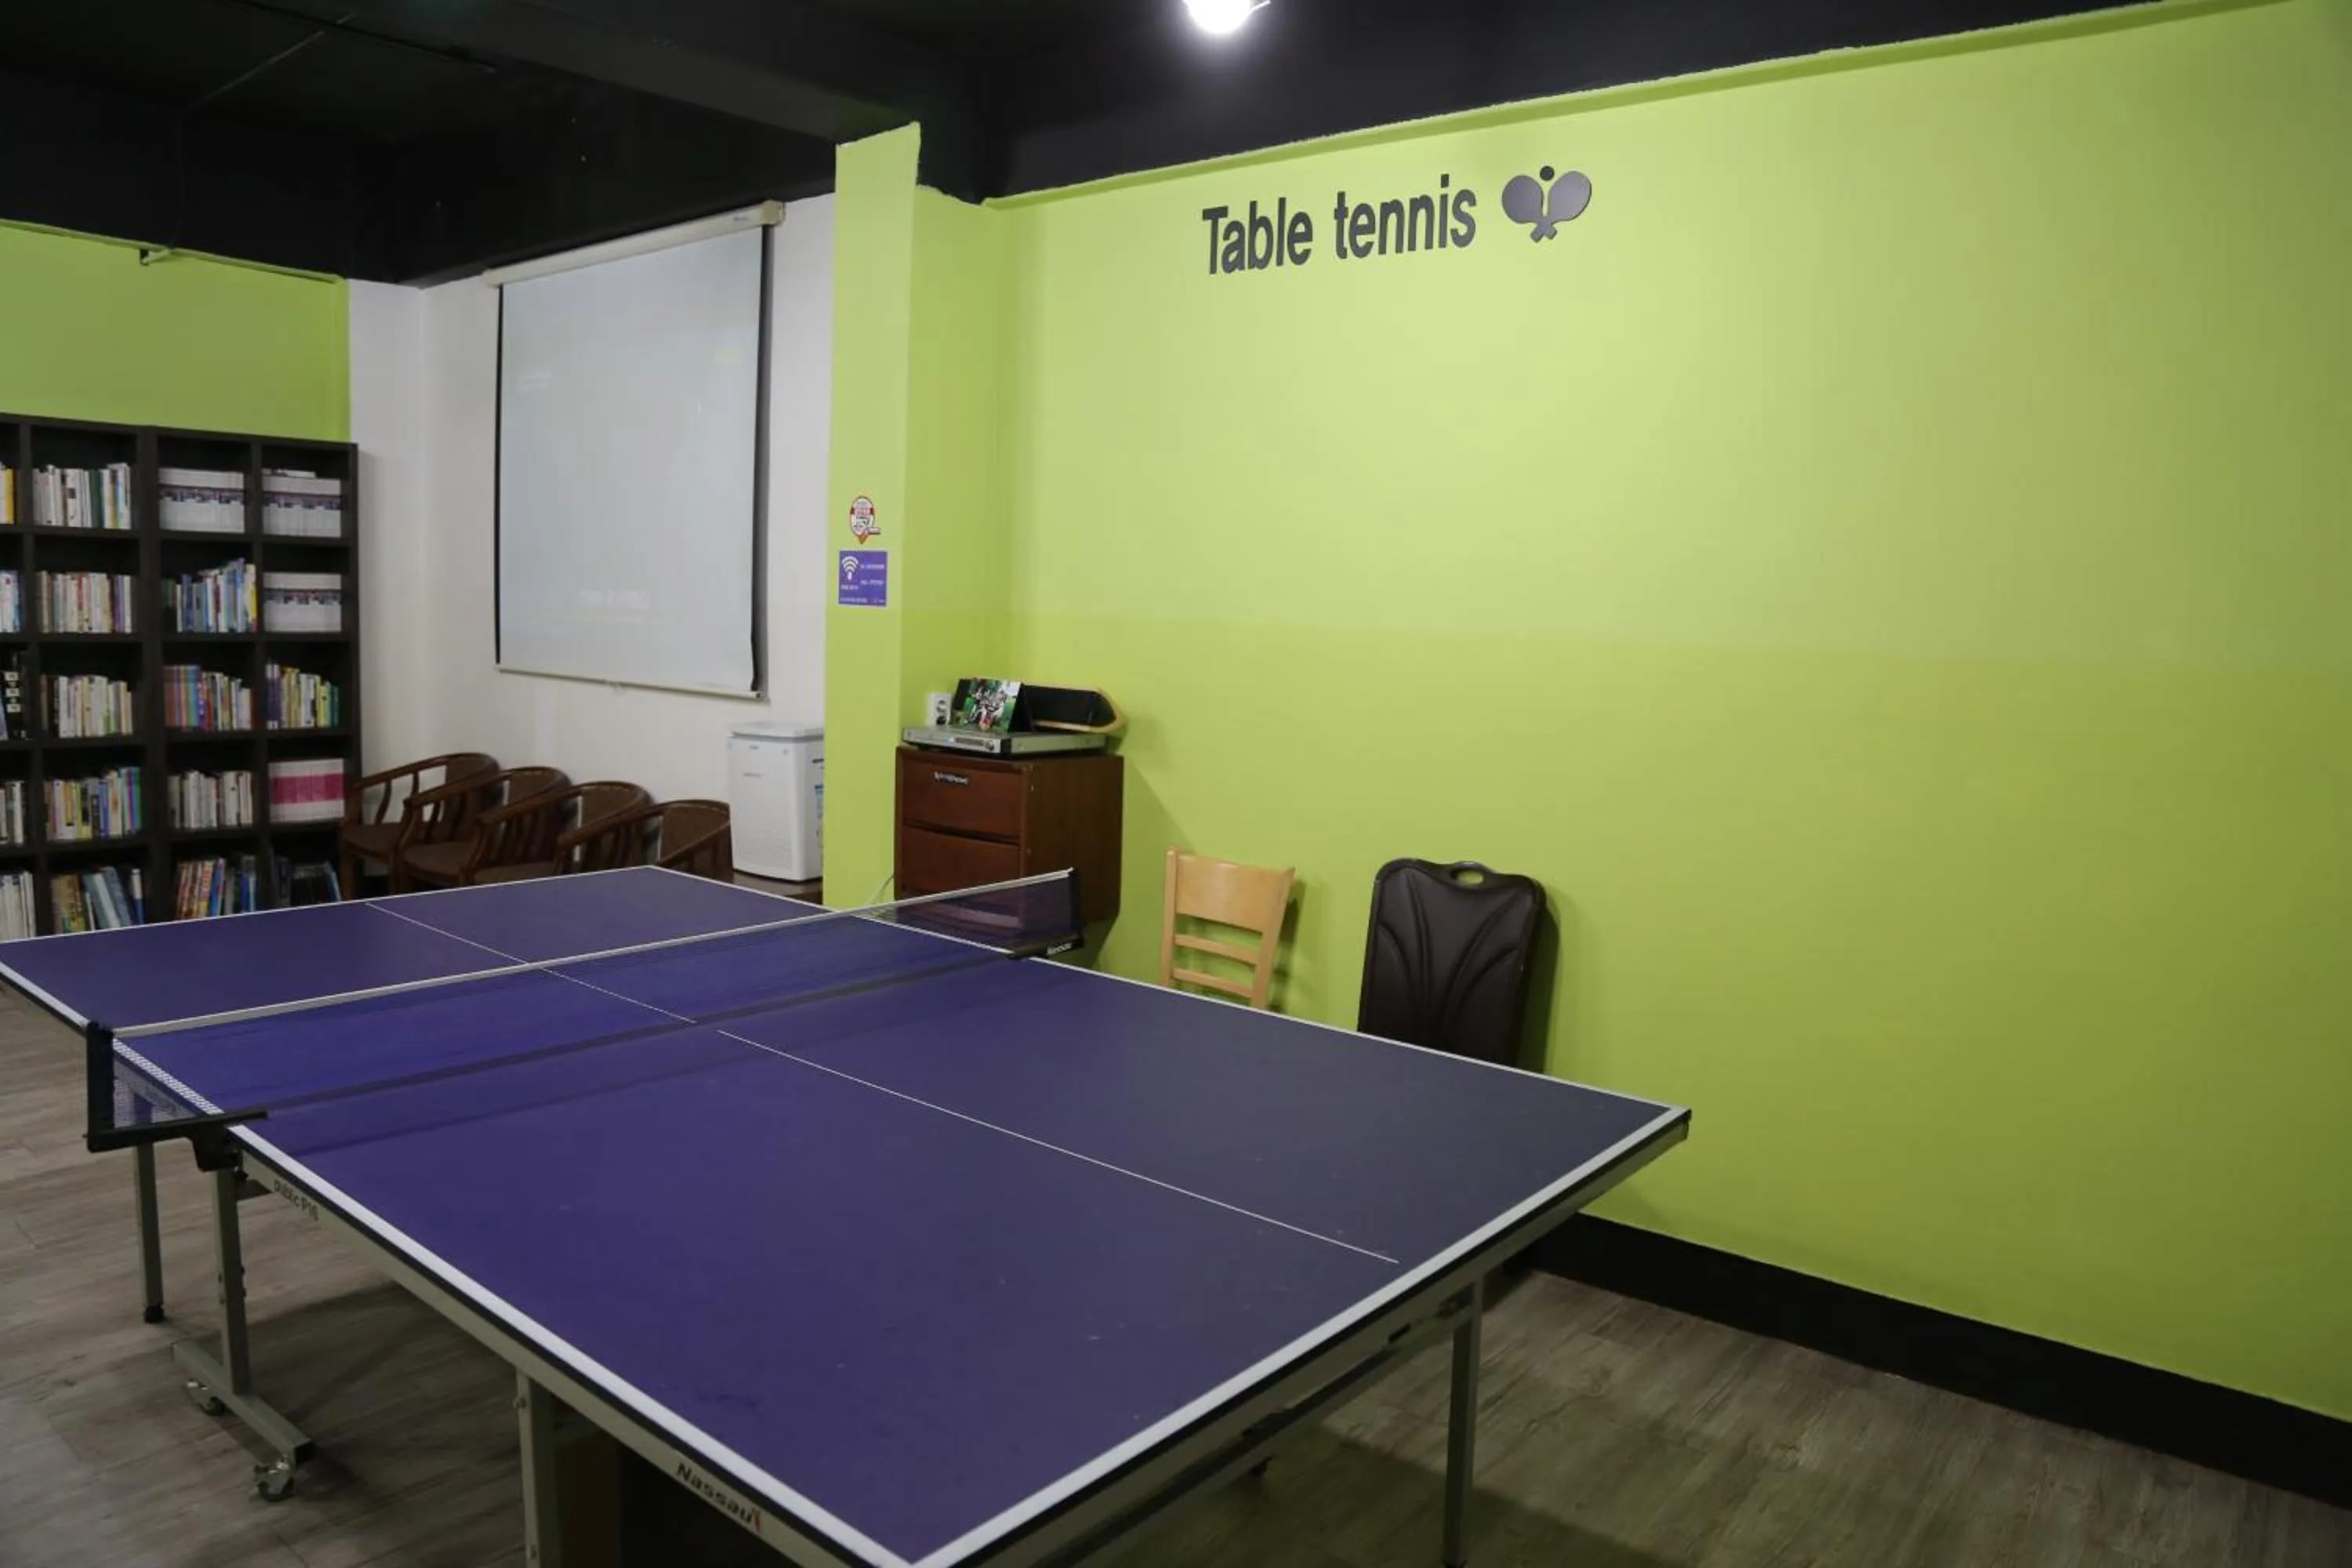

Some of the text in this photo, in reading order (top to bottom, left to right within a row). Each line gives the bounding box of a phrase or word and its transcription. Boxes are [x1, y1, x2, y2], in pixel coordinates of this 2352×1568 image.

[1202, 173, 1476, 274] Table tennis
[677, 1463, 753, 1523] Nassau
